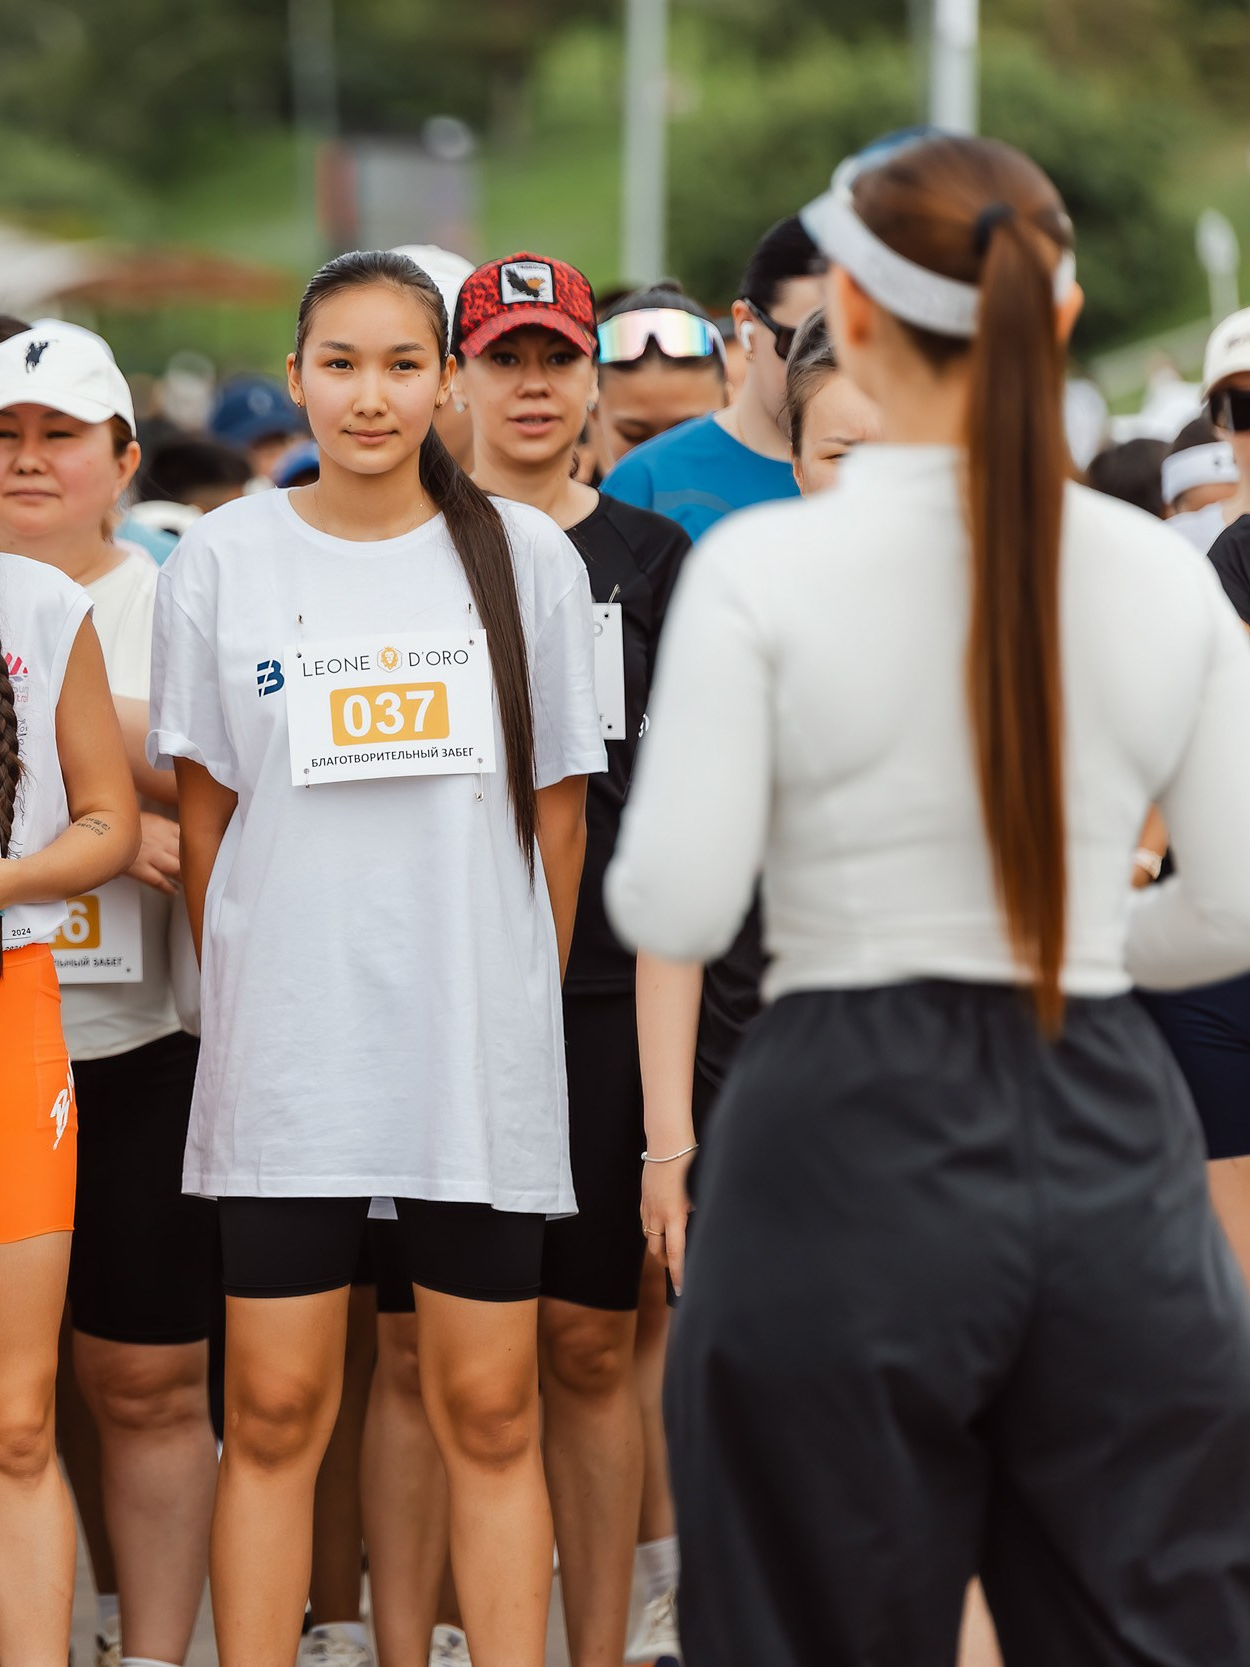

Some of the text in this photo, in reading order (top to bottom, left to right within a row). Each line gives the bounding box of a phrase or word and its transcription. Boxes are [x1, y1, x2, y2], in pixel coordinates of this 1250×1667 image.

[302, 649, 470, 677] LEONE D'ORO
[343, 689, 435, 738] 037
[311, 746, 474, 768] БЛАГОТВОРИТЕЛЬНЫЙ ЗАБЕГ
[11, 927, 32, 937] 2024
